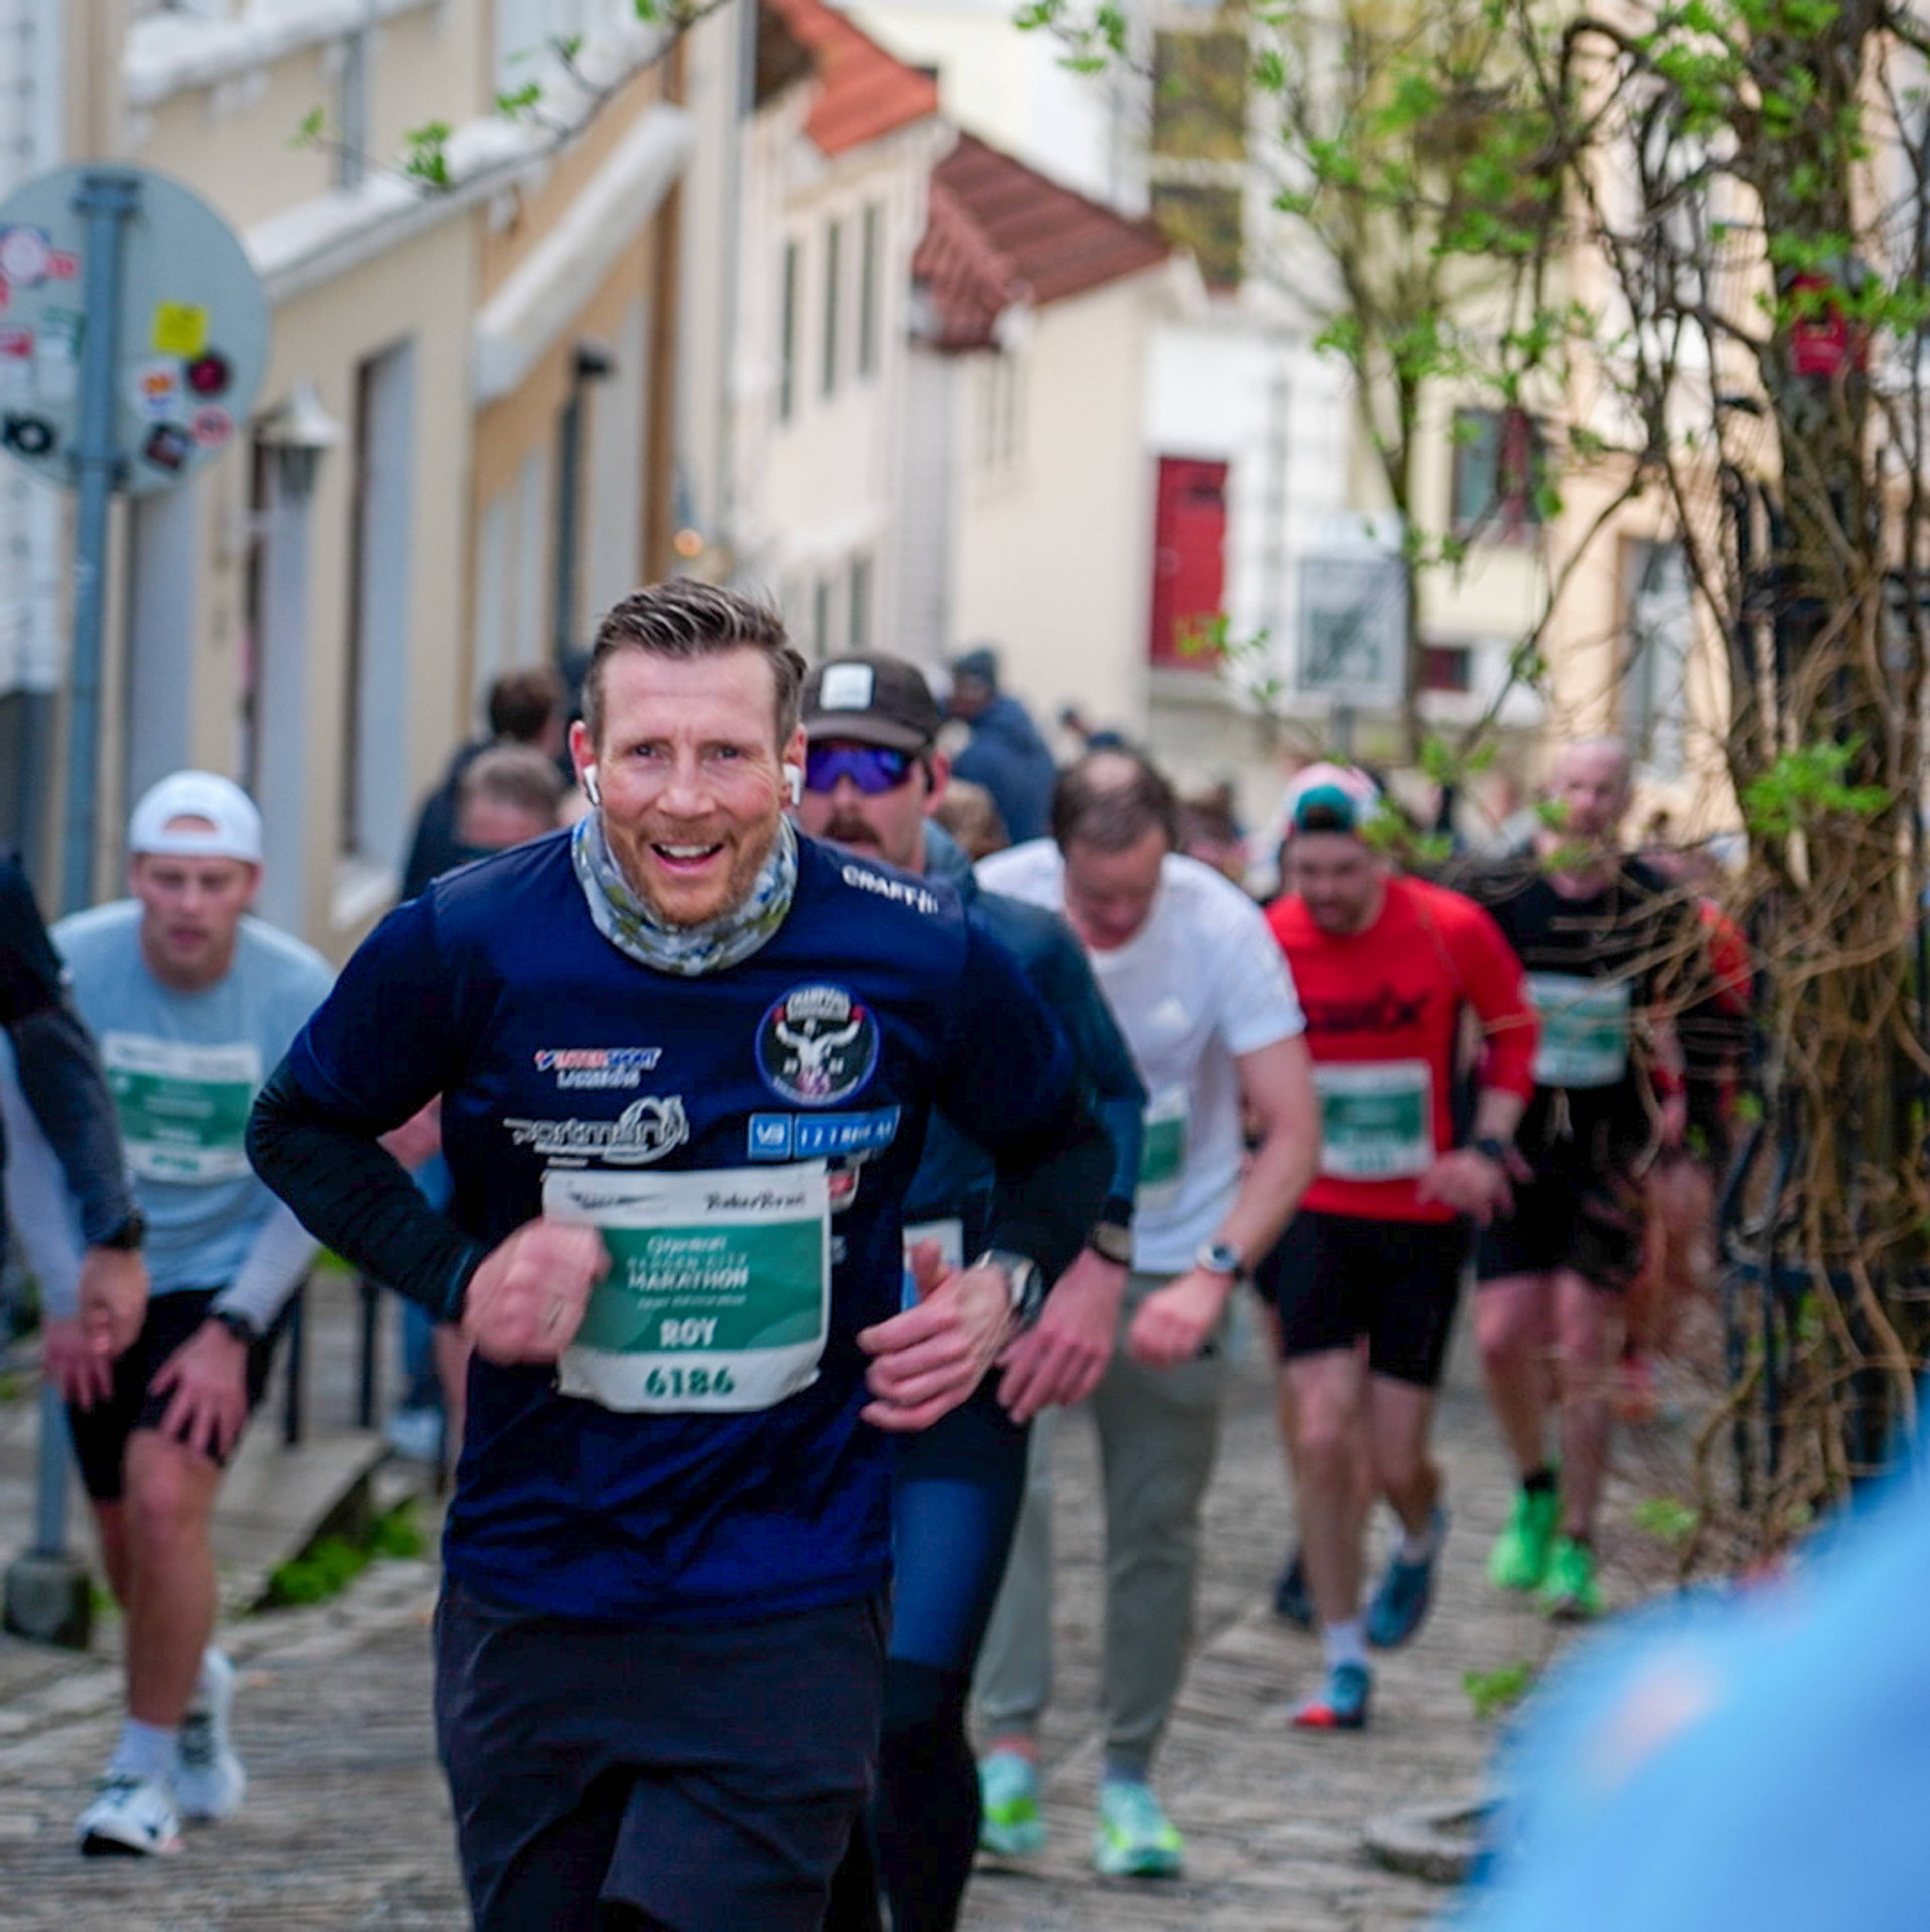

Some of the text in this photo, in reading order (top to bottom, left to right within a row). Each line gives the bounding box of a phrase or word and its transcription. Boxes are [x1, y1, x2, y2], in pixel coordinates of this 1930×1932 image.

[842, 864, 917, 906] CRAFT
[628, 1267, 748, 1291] MARATHON
[660, 1316, 718, 1347] ROY
[644, 1366, 735, 1398] 6186
